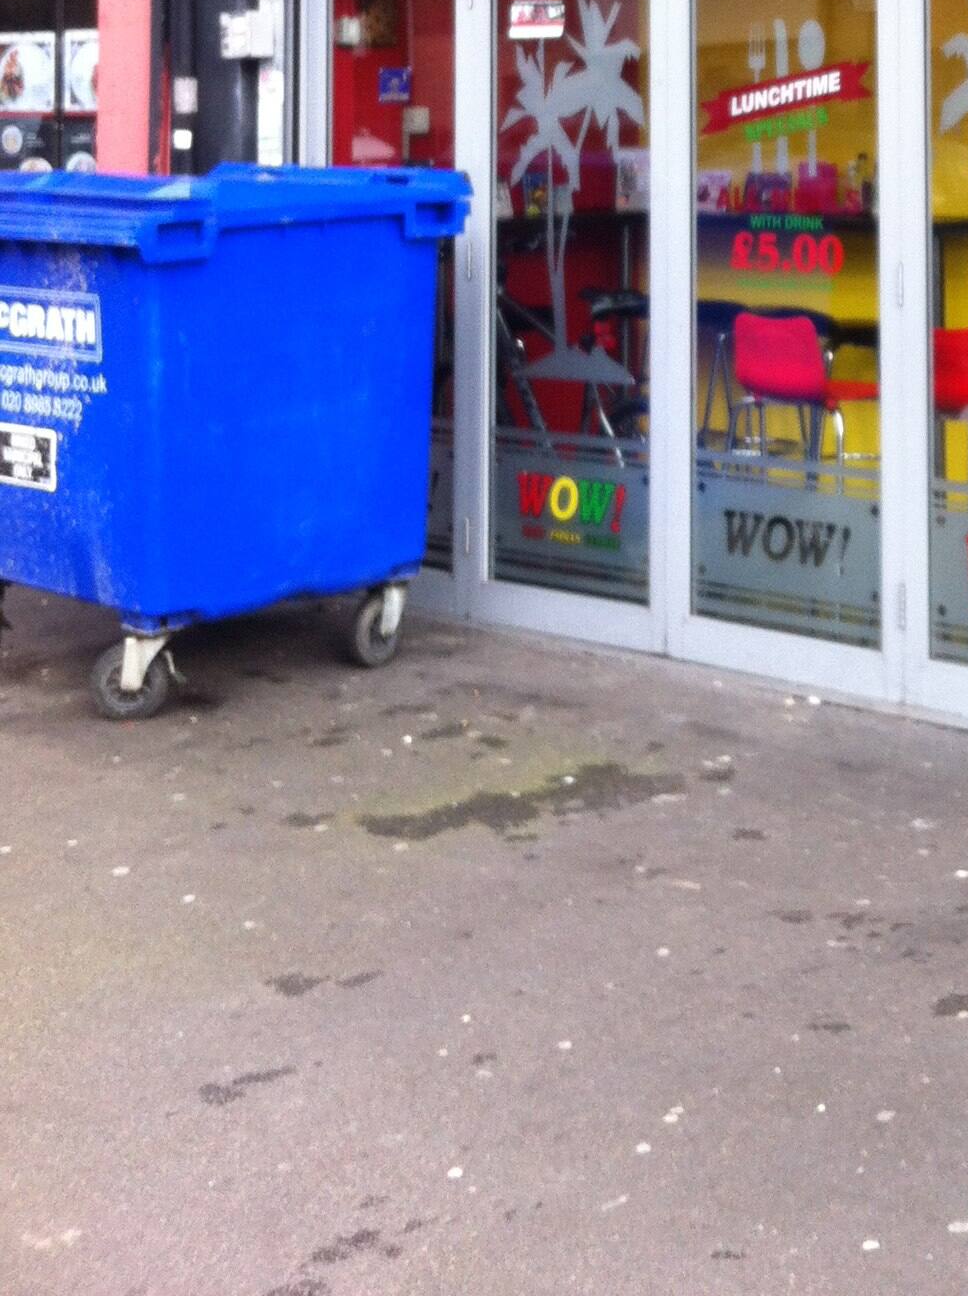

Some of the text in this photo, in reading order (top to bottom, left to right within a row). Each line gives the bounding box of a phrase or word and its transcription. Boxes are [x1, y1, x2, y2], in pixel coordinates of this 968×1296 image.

[730, 71, 842, 117] LUNCHTIME
[729, 230, 845, 277] £5.00
[517, 472, 626, 533] WOW!
[724, 509, 851, 575] WOW!
